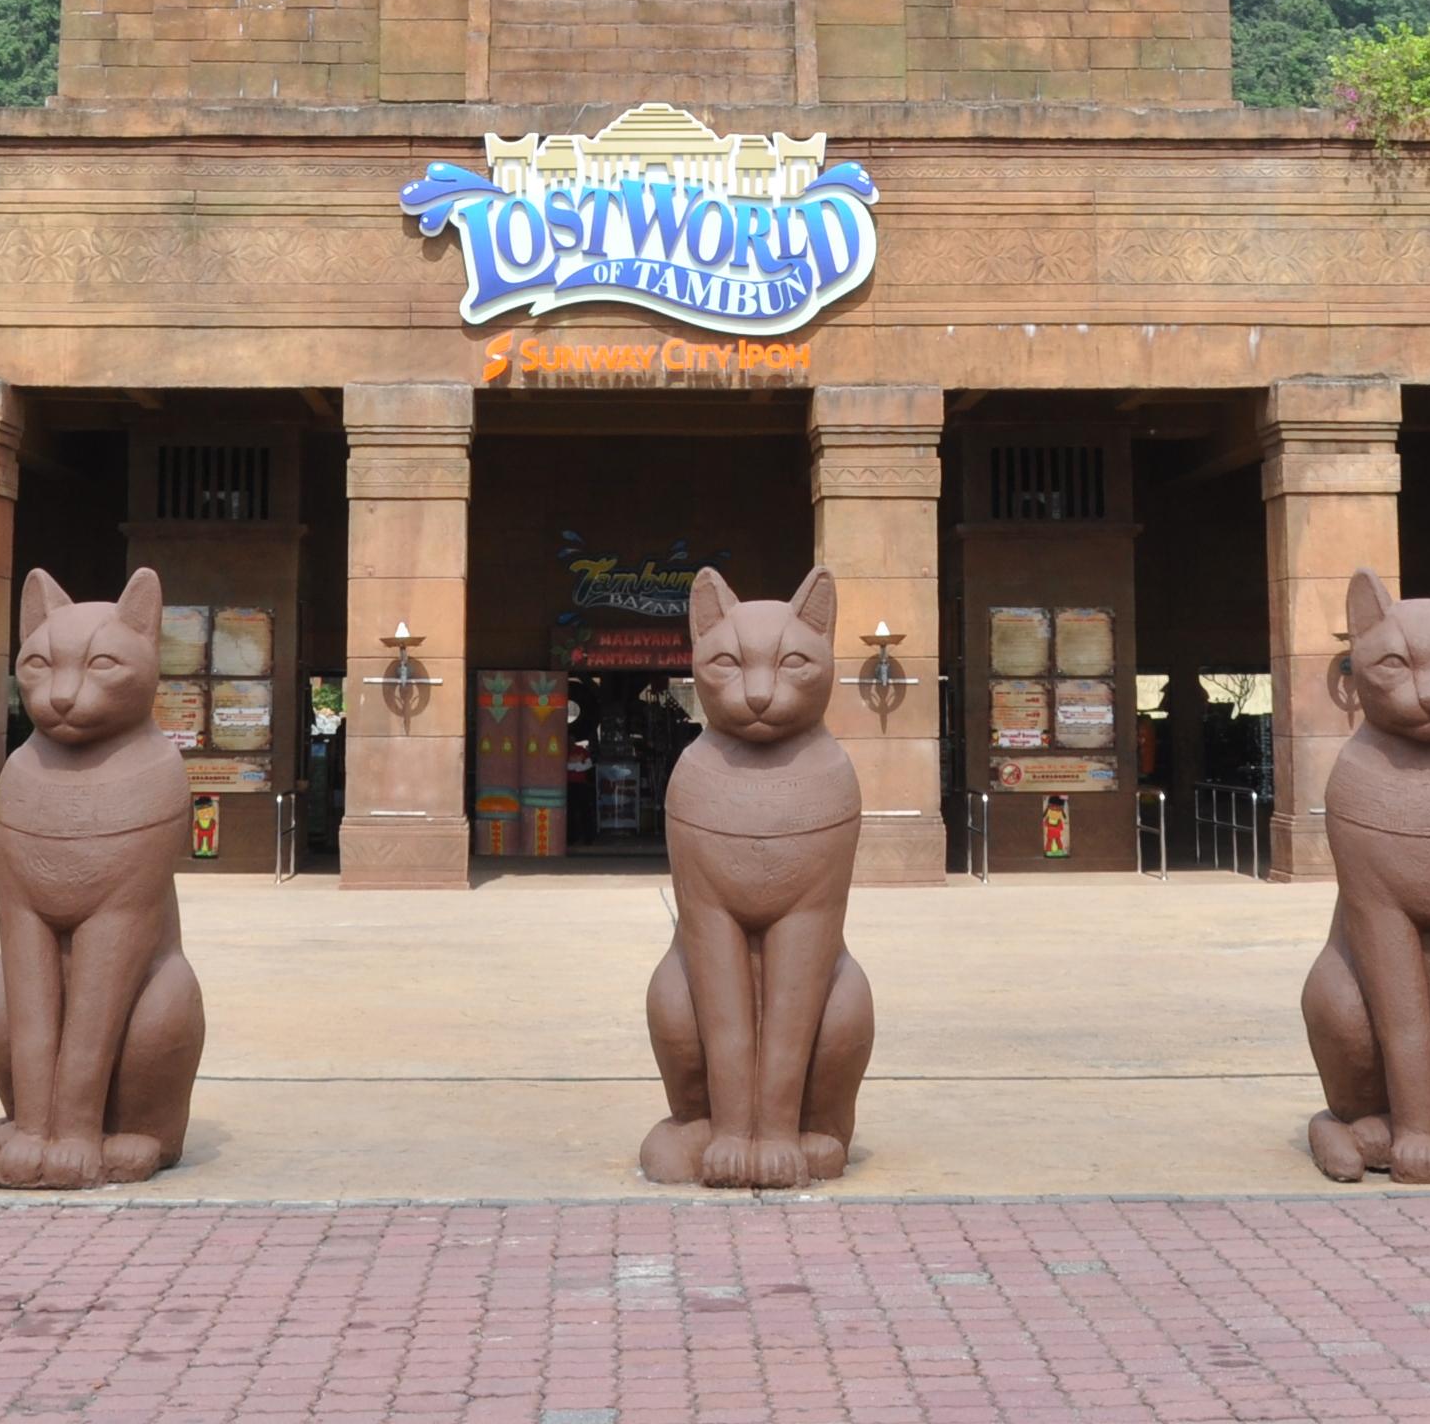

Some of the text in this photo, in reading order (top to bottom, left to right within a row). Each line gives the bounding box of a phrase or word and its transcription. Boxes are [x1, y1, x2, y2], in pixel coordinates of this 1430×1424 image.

[593, 260, 807, 316] OF TAMBUN
[521, 338, 811, 372] SUNWAY CITY IPOH
